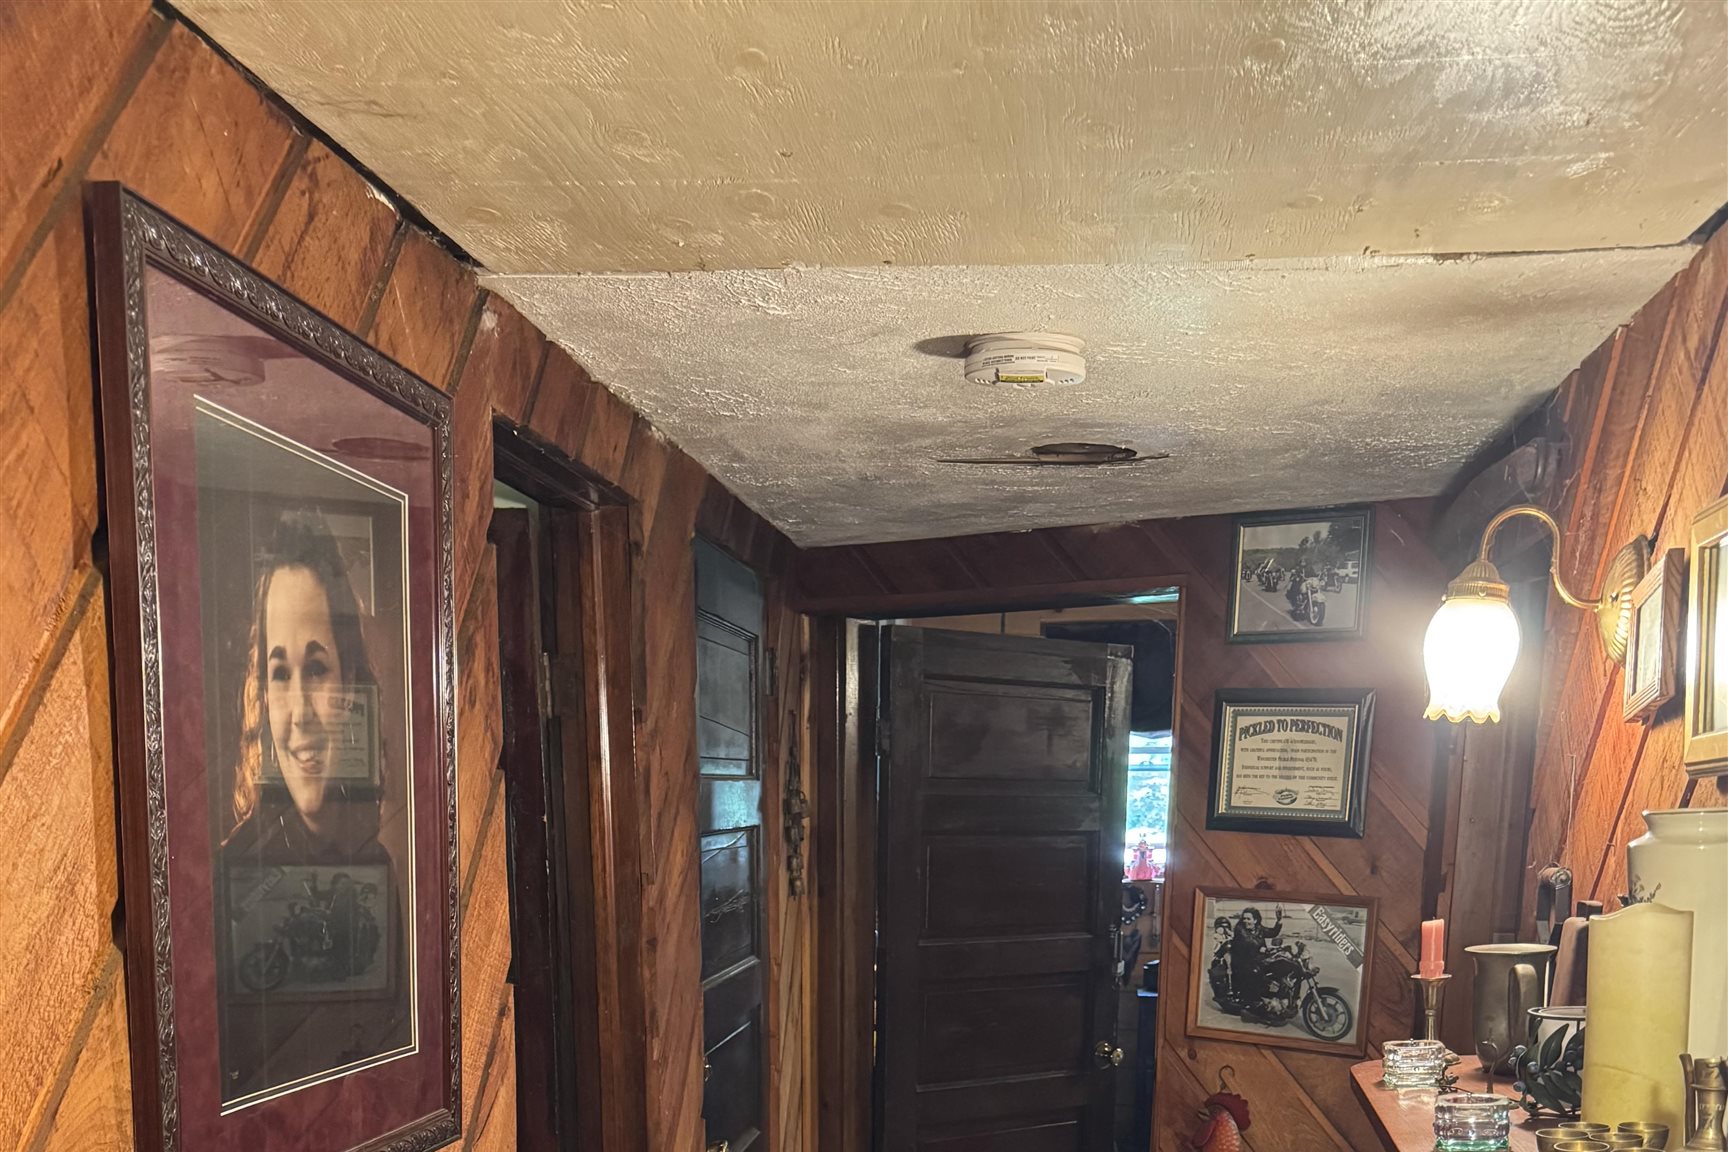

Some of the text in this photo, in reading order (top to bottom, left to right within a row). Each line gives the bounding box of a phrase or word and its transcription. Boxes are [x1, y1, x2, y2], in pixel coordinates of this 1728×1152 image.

[1239, 719, 1343, 742] PICKLED TO PERFECTION
[1313, 907, 1354, 955] Easyriders
